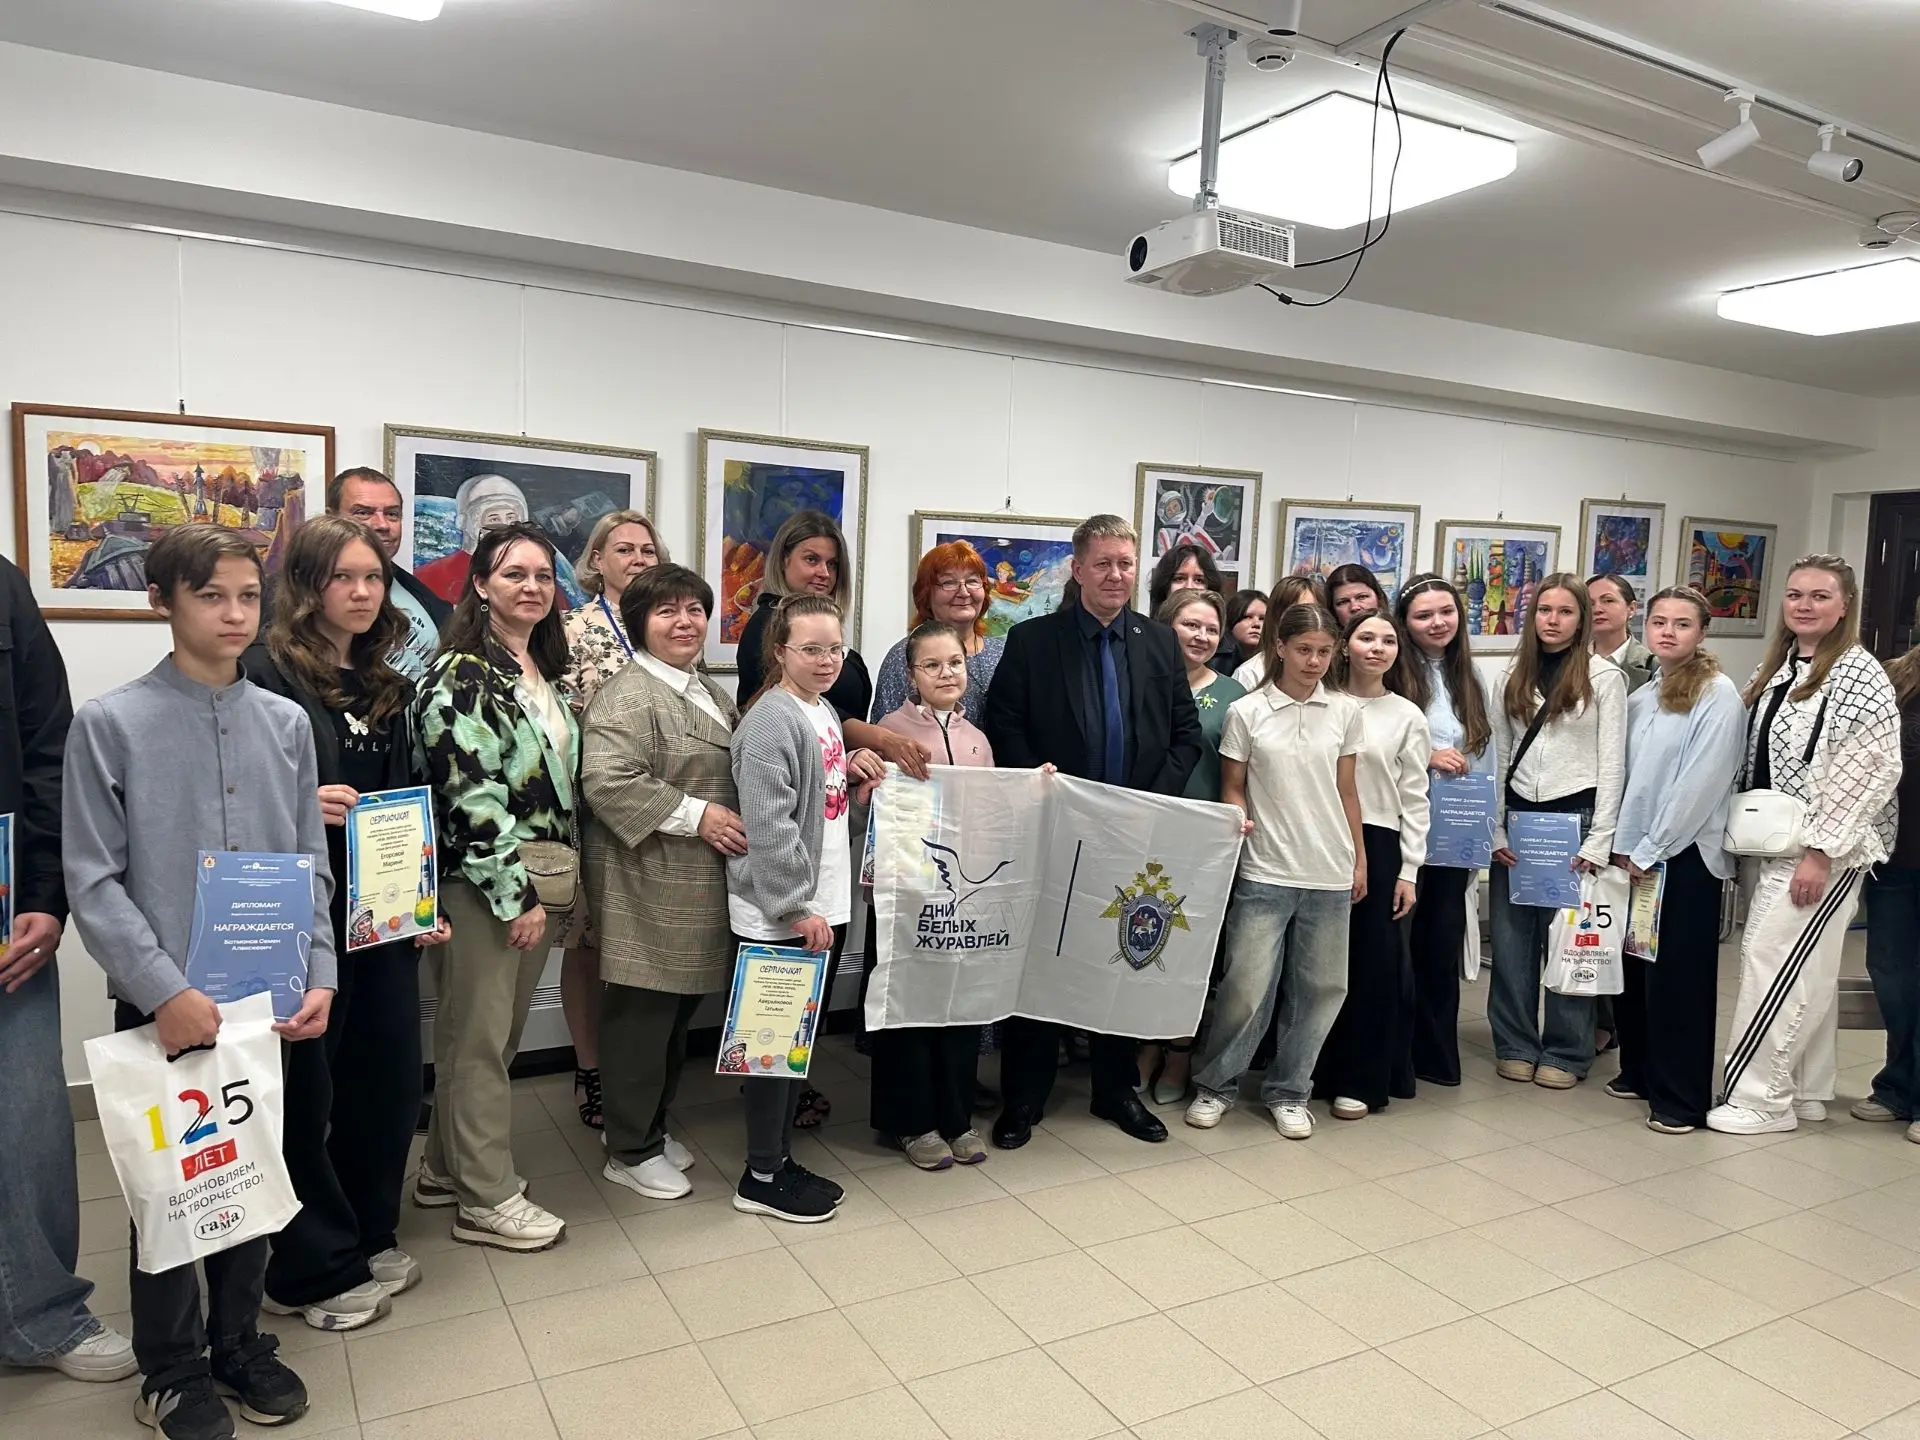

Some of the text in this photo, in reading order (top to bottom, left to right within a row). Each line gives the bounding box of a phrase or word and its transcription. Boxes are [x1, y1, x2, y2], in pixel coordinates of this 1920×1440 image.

[369, 810, 410, 826] СЕРТИФИКАТ
[919, 903, 955, 919] ДНИ
[213, 922, 295, 933] НАГРАЖДАЕТСЯ
[917, 919, 977, 934] БЕЛЫХ
[915, 929, 1009, 949] ЖУРАВЛЕЙ
[760, 965, 803, 975] СЕРТИФИКАТ
[141, 1078, 254, 1154] 125
[194, 1145, 228, 1175] ЛЕТ
[169, 1161, 256, 1207] ВДОХНОВЛЯЕМ
[168, 1173, 265, 1222] НА ТВОРЧЕСТВО!
